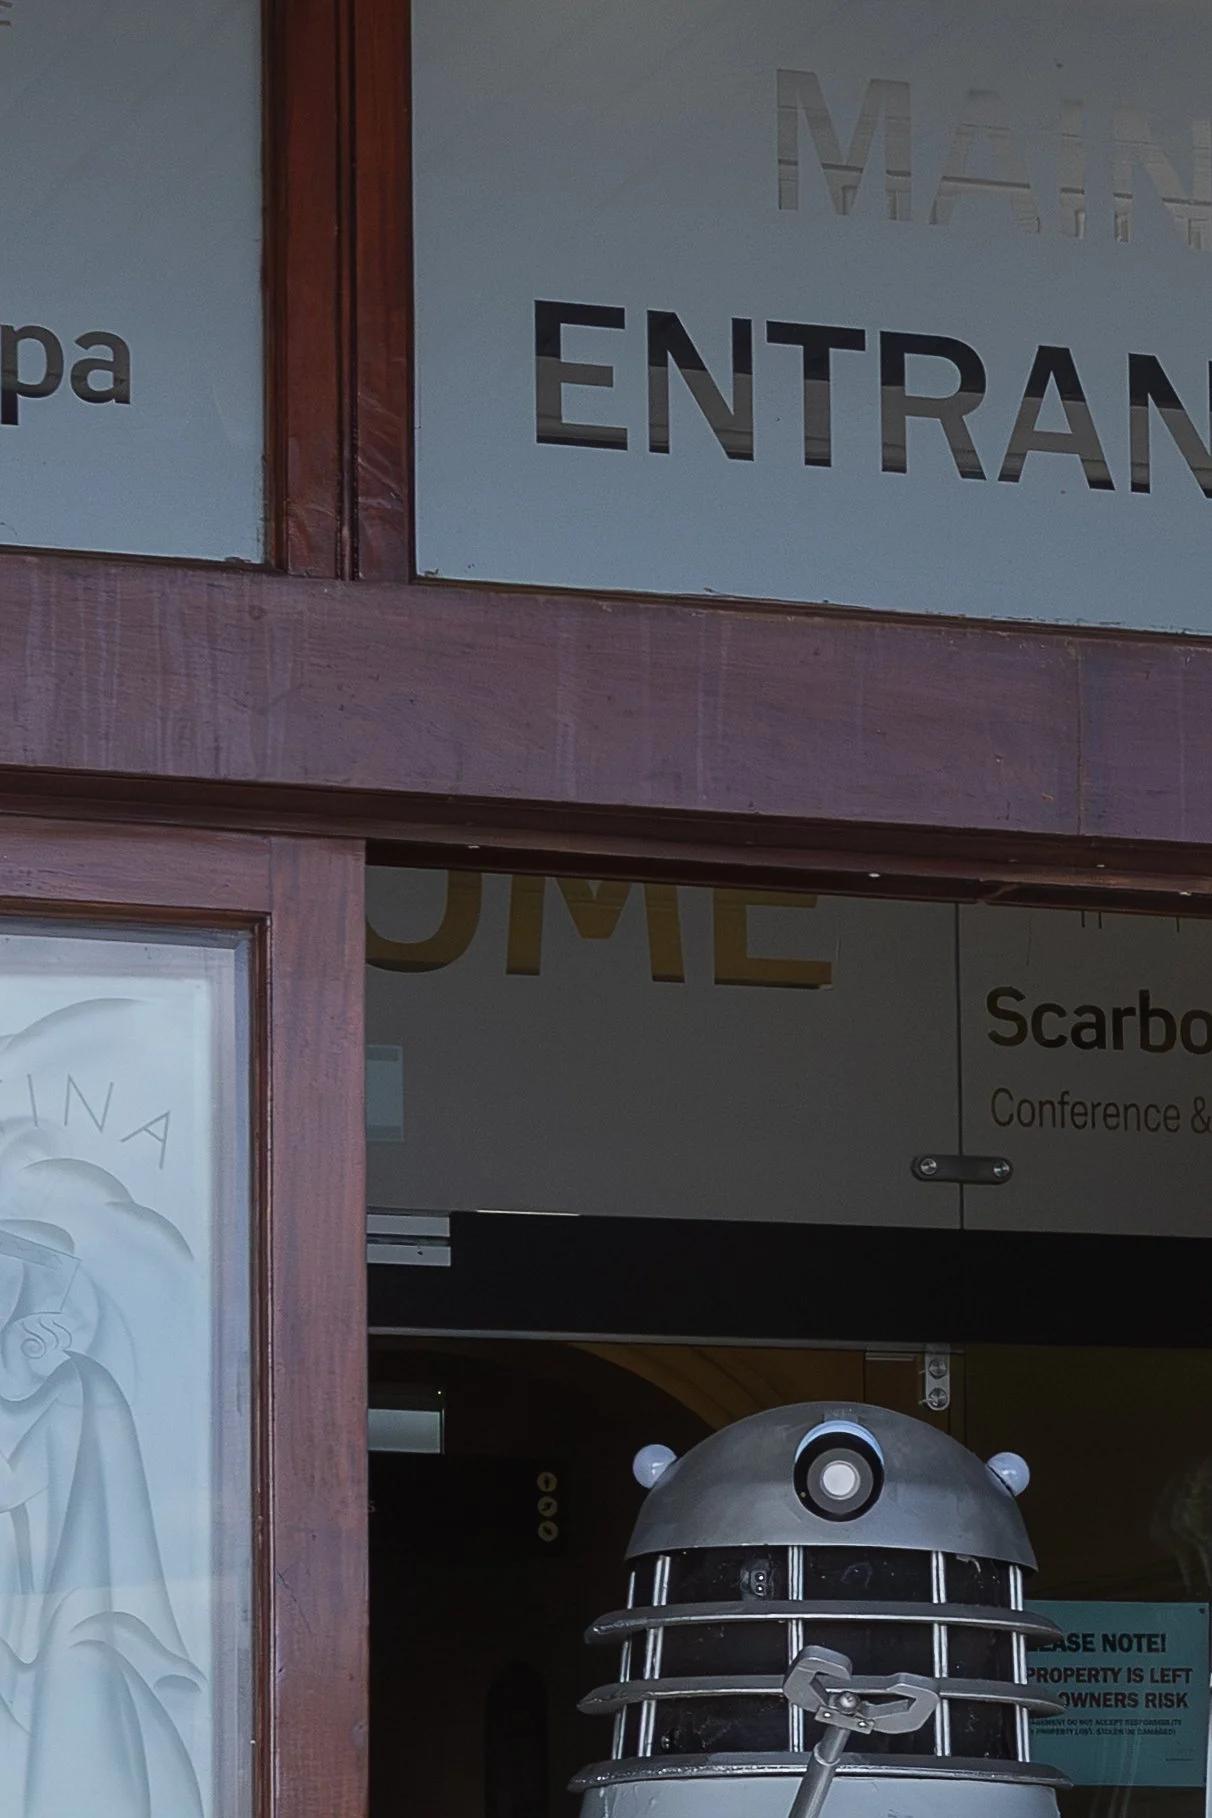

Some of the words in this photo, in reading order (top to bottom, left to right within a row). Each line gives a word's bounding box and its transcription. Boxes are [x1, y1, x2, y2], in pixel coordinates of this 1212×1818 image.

[991, 1087, 1180, 1134] Conference
[1190, 1095, 1212, 1135] &
[1102, 1633, 1167, 1653] NOTE!
[1127, 1667, 1144, 1684] IS
[1150, 1667, 1193, 1684] LEFT
[1144, 1692, 1189, 1709] RISK
